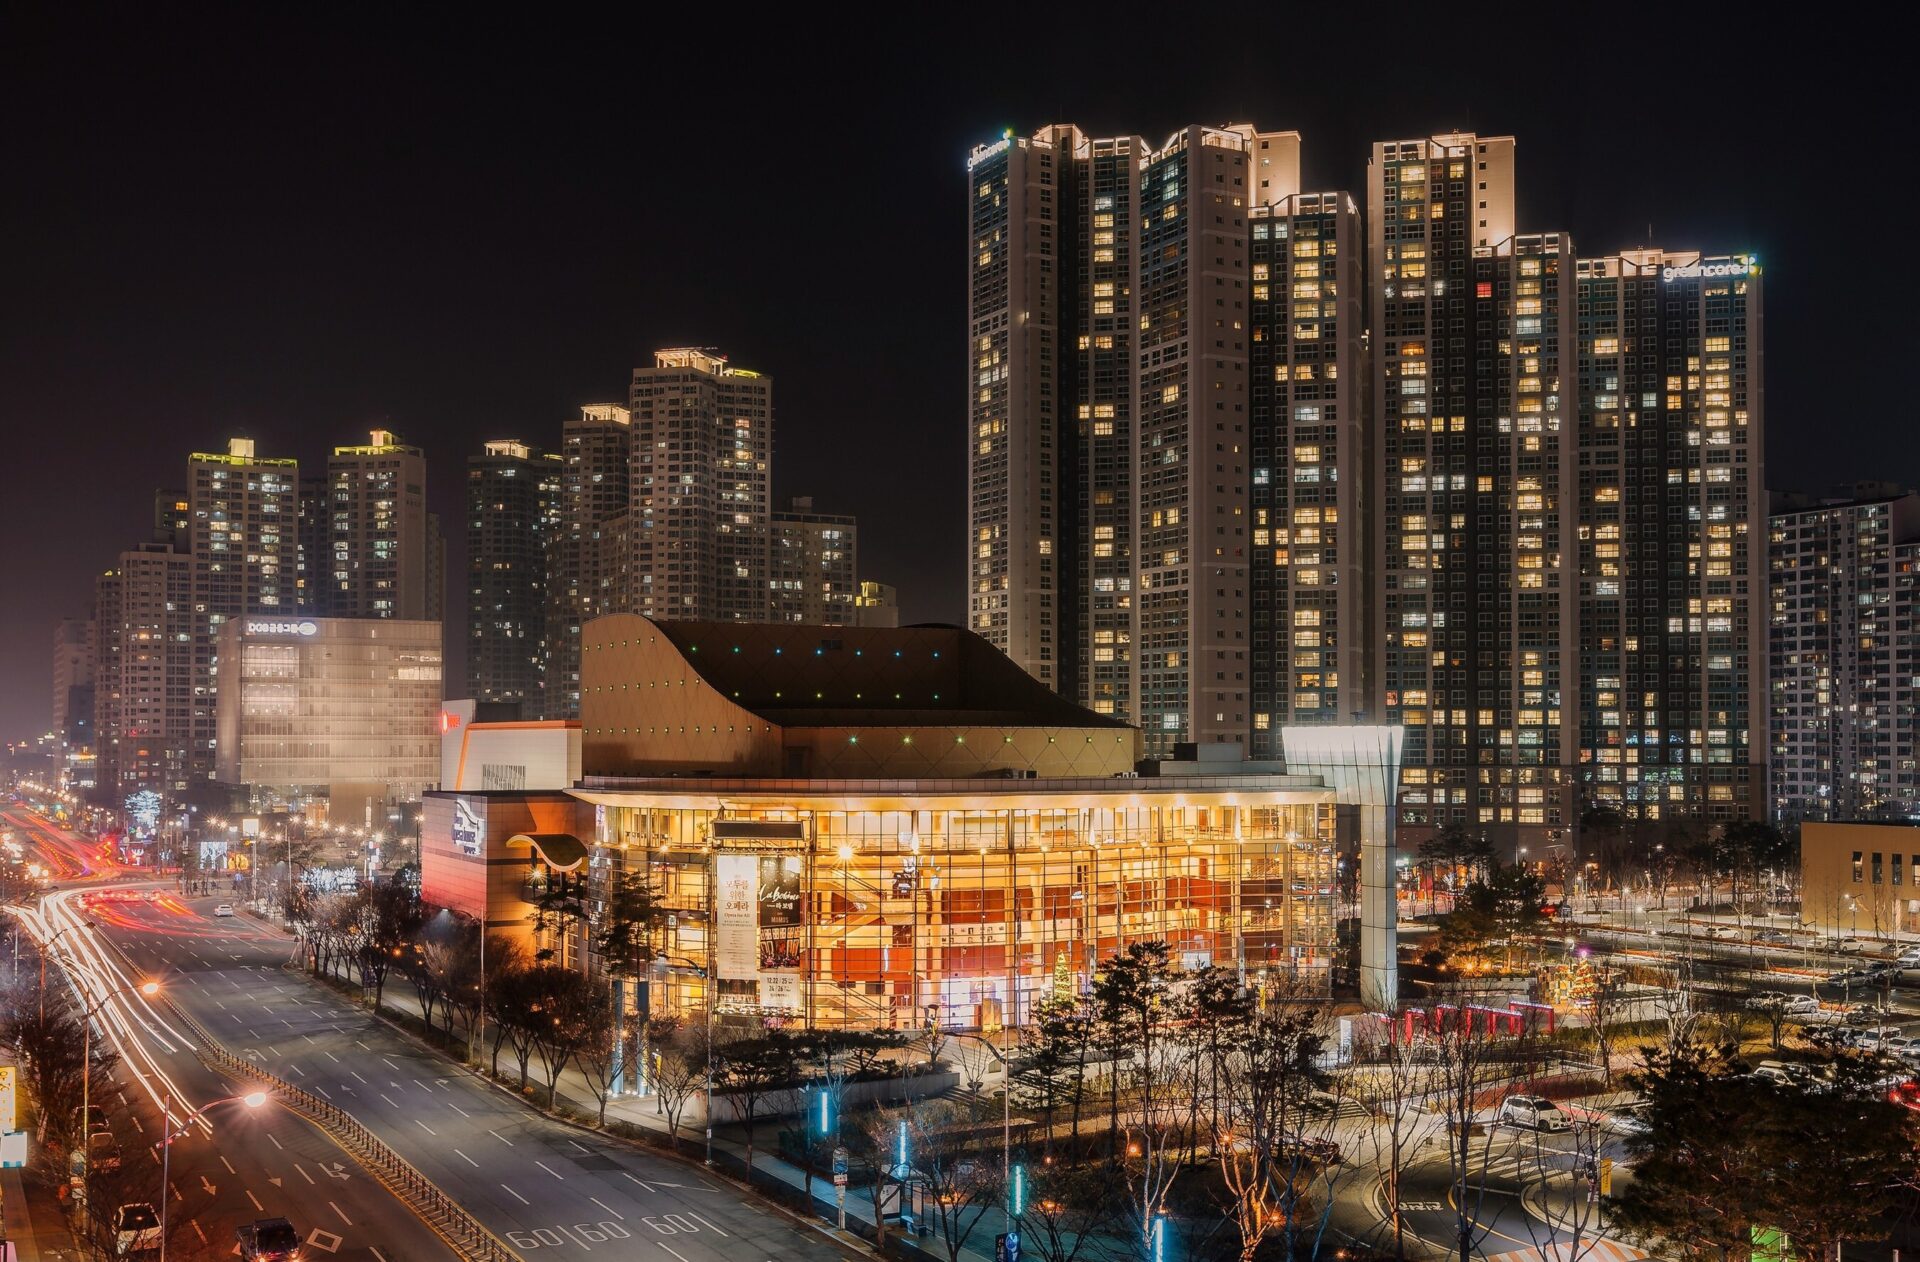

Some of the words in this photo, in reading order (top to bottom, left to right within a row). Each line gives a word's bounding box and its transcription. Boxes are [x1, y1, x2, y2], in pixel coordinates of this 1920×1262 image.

[1662, 264, 1738, 283] greencore
[729, 890, 745, 900] 위한
[725, 901, 749, 911] 오페라
[573, 1221, 631, 1242] 60
[641, 1214, 700, 1235] 60
[505, 1228, 564, 1249] 60
